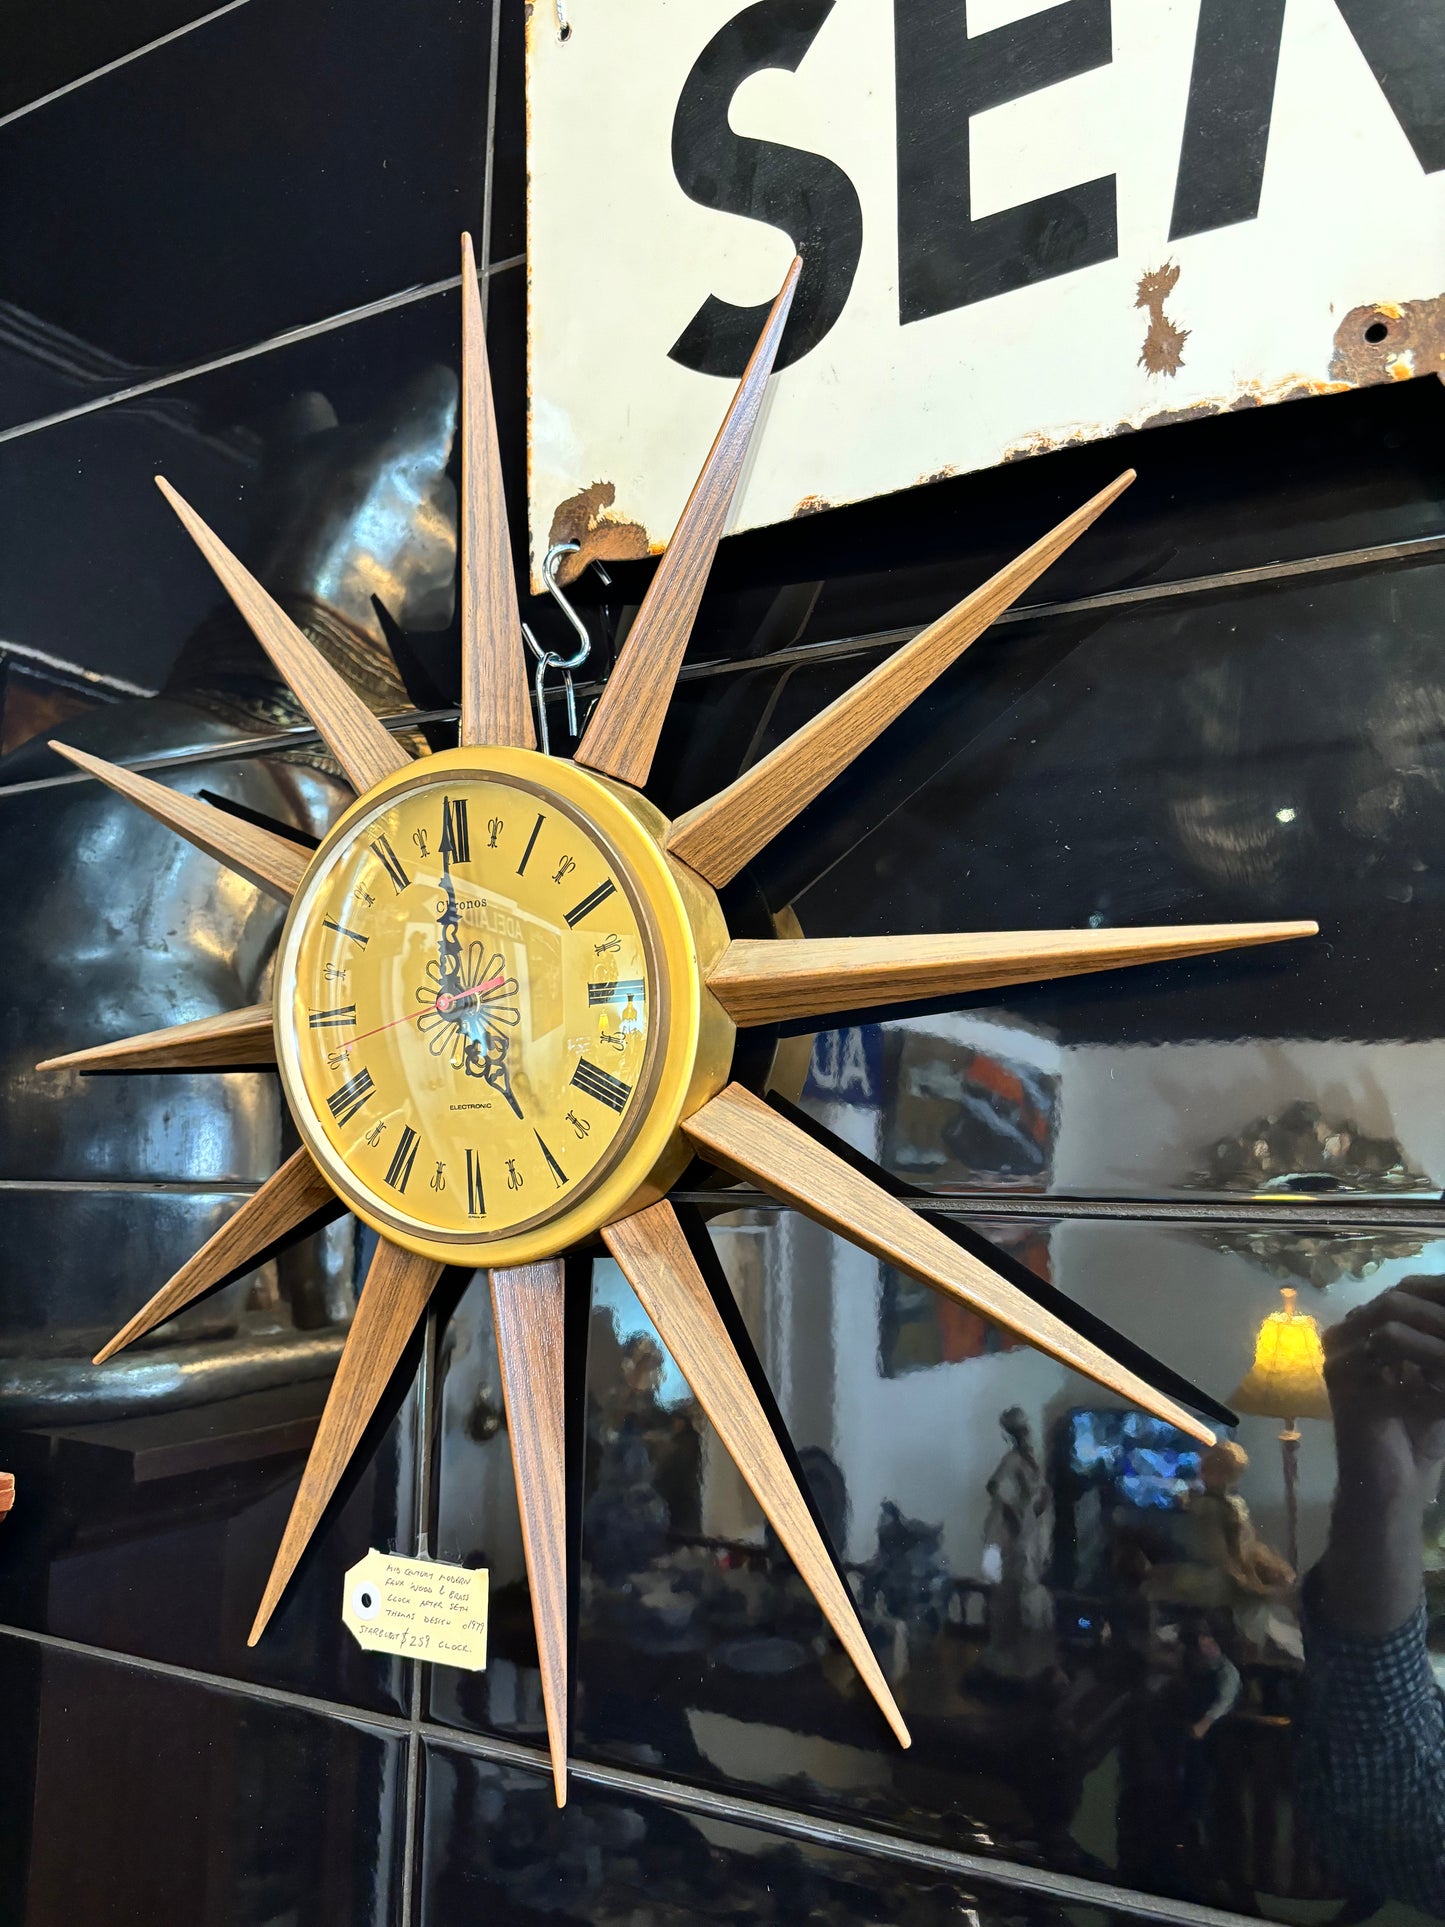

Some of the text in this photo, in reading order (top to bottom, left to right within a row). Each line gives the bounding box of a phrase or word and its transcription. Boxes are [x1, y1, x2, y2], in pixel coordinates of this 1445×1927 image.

[438, 1574, 471, 1585] MODERN
[410, 1582, 433, 1593] WOOD
[448, 1590, 470, 1601] BRASS
[387, 1594, 469, 1612] CLOCK AFTER SETH
[385, 1609, 416, 1620] THOMAS
[423, 1615, 451, 1626] DESIGN
